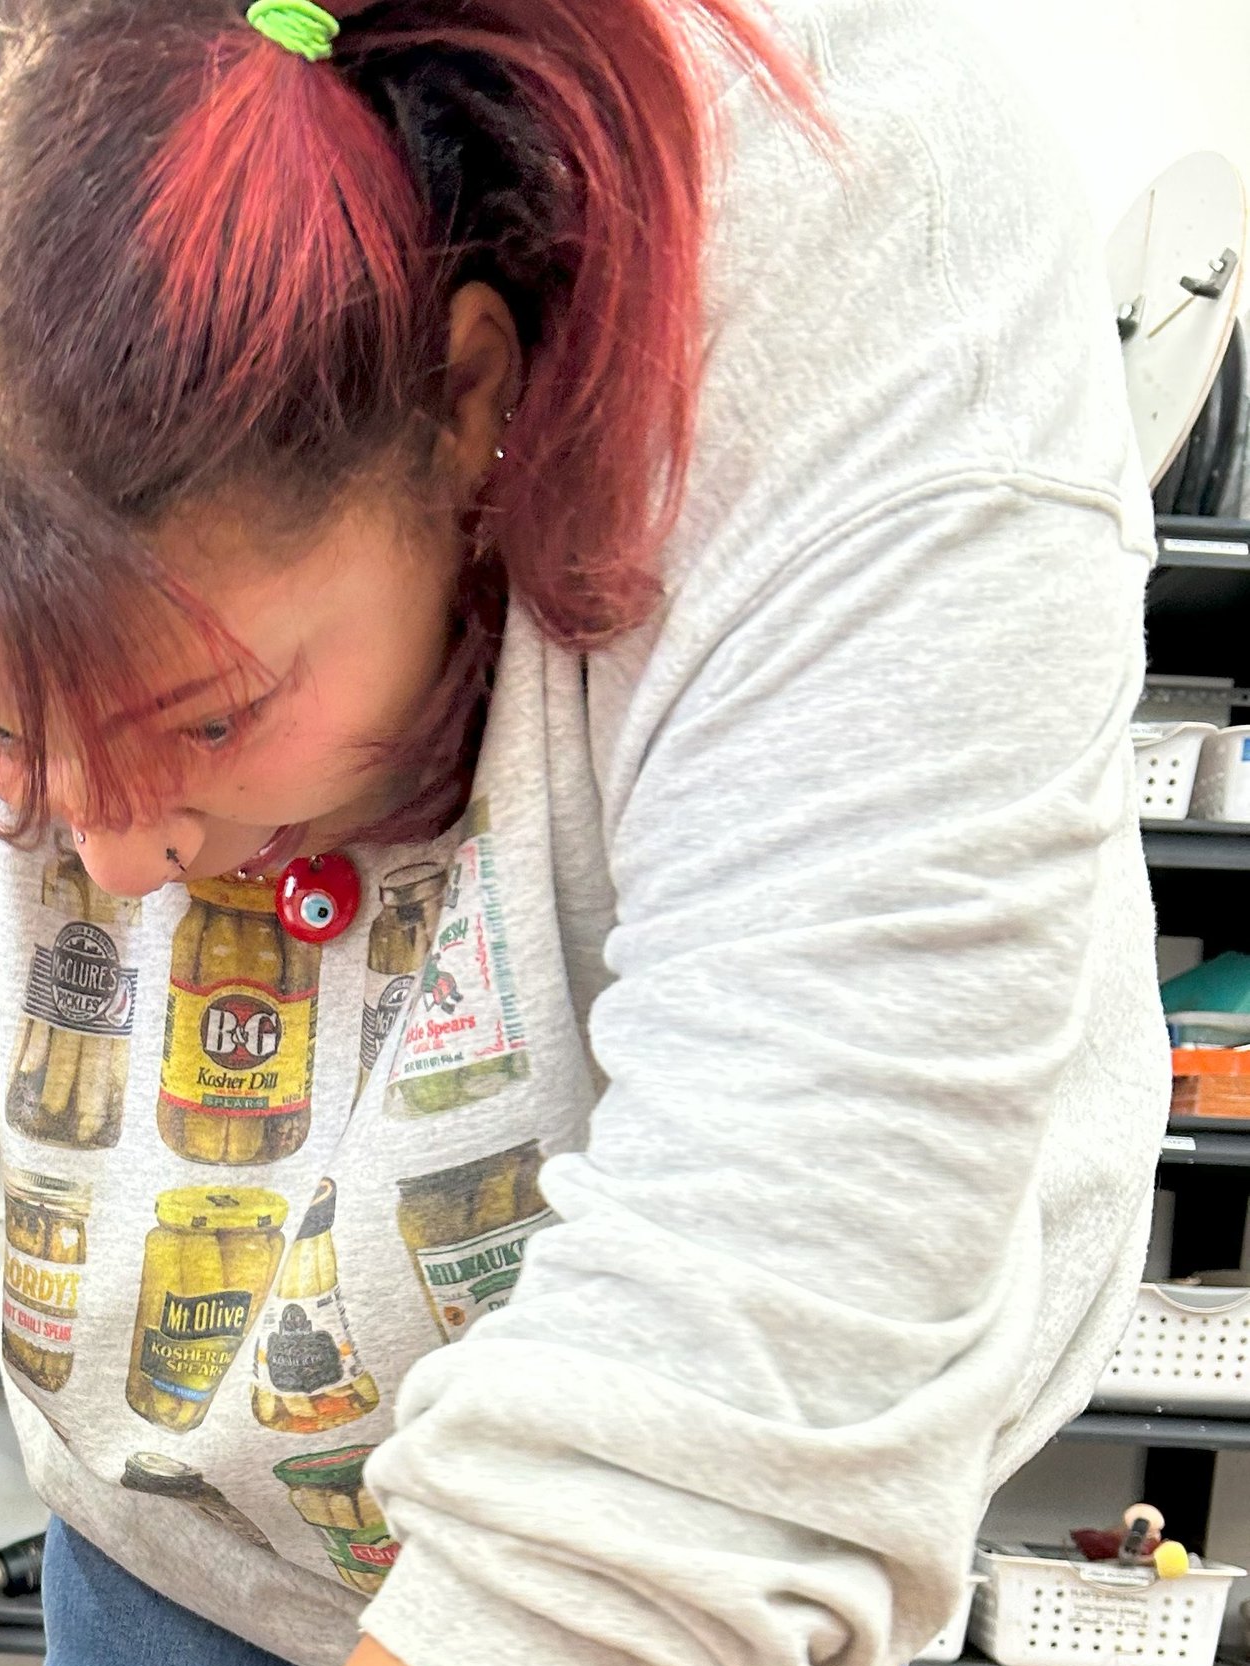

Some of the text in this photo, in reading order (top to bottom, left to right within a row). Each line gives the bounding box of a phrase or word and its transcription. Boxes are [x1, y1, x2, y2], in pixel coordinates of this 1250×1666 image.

[205, 1008, 278, 1057] B&G
[427, 1014, 476, 1041] Spears
[196, 1066, 279, 1090] Kosher Dill
[206, 1096, 265, 1109] SPEARS
[167, 1299, 245, 1332] Mt. Olive
[151, 1341, 217, 1364] KOSHER
